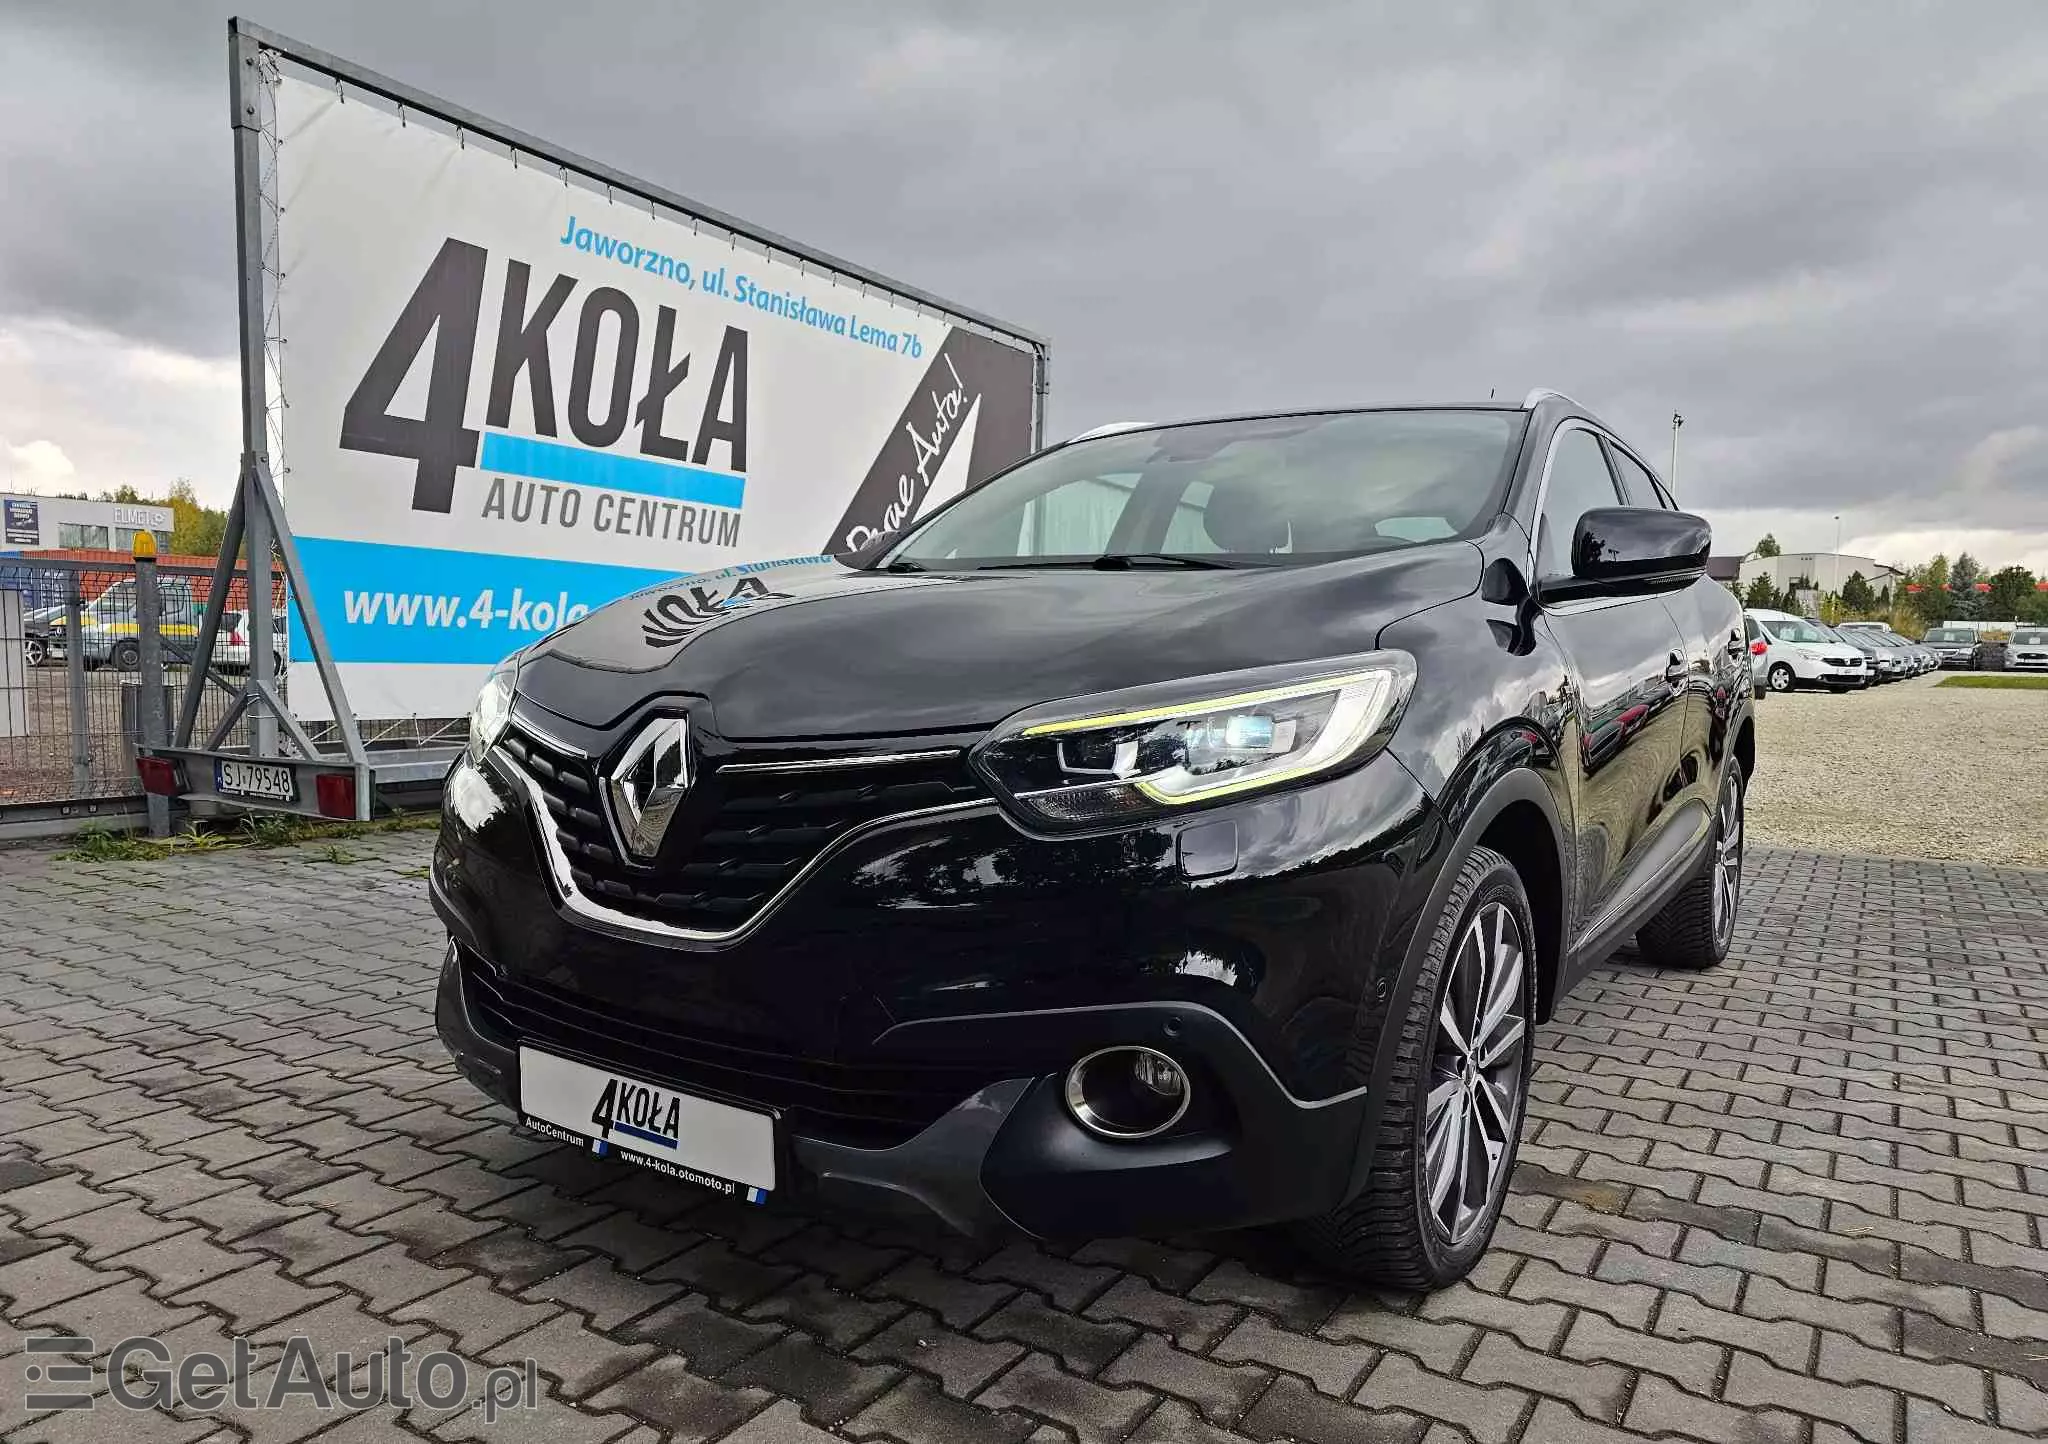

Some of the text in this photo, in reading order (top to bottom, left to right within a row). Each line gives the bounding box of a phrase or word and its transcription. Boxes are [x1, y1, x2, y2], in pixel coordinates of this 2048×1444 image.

[560, 216, 923, 359] Jaworzno, ul. Stanisława Lema 7b
[906, 352, 968, 487] Auta!
[481, 478, 743, 549] AUTO CENTRUM
[525, 1115, 585, 1147] AutoCentrum
[620, 1149, 735, 1196] www.4-kola.otomoto.pl
